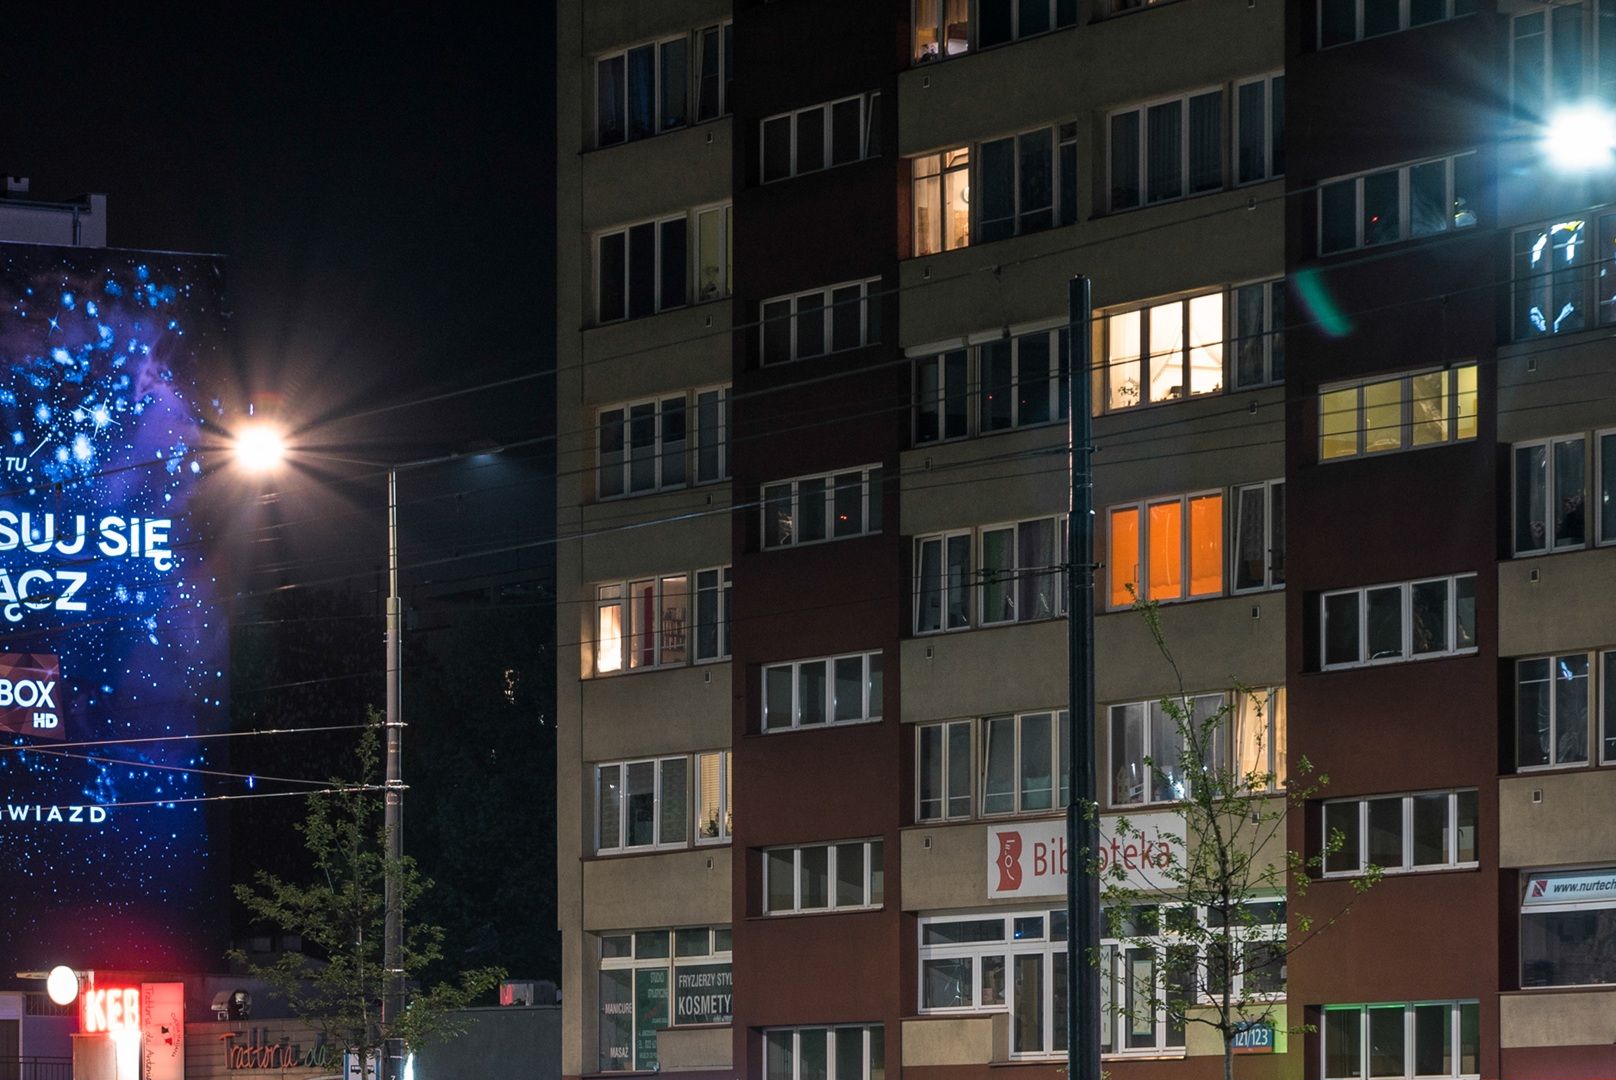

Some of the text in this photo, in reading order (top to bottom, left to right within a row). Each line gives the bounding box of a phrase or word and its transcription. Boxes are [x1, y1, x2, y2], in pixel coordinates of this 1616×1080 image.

[5, 456, 27, 472] TU
[98, 515, 172, 571] SIĘ
[33, 713, 58, 729] HD
[1034, 832, 1170, 876] Biboteka
[678, 974, 715, 988] FRYZJERZY
[678, 994, 731, 1015] KOSMETY
[1235, 1028, 1268, 1047] 121/123
